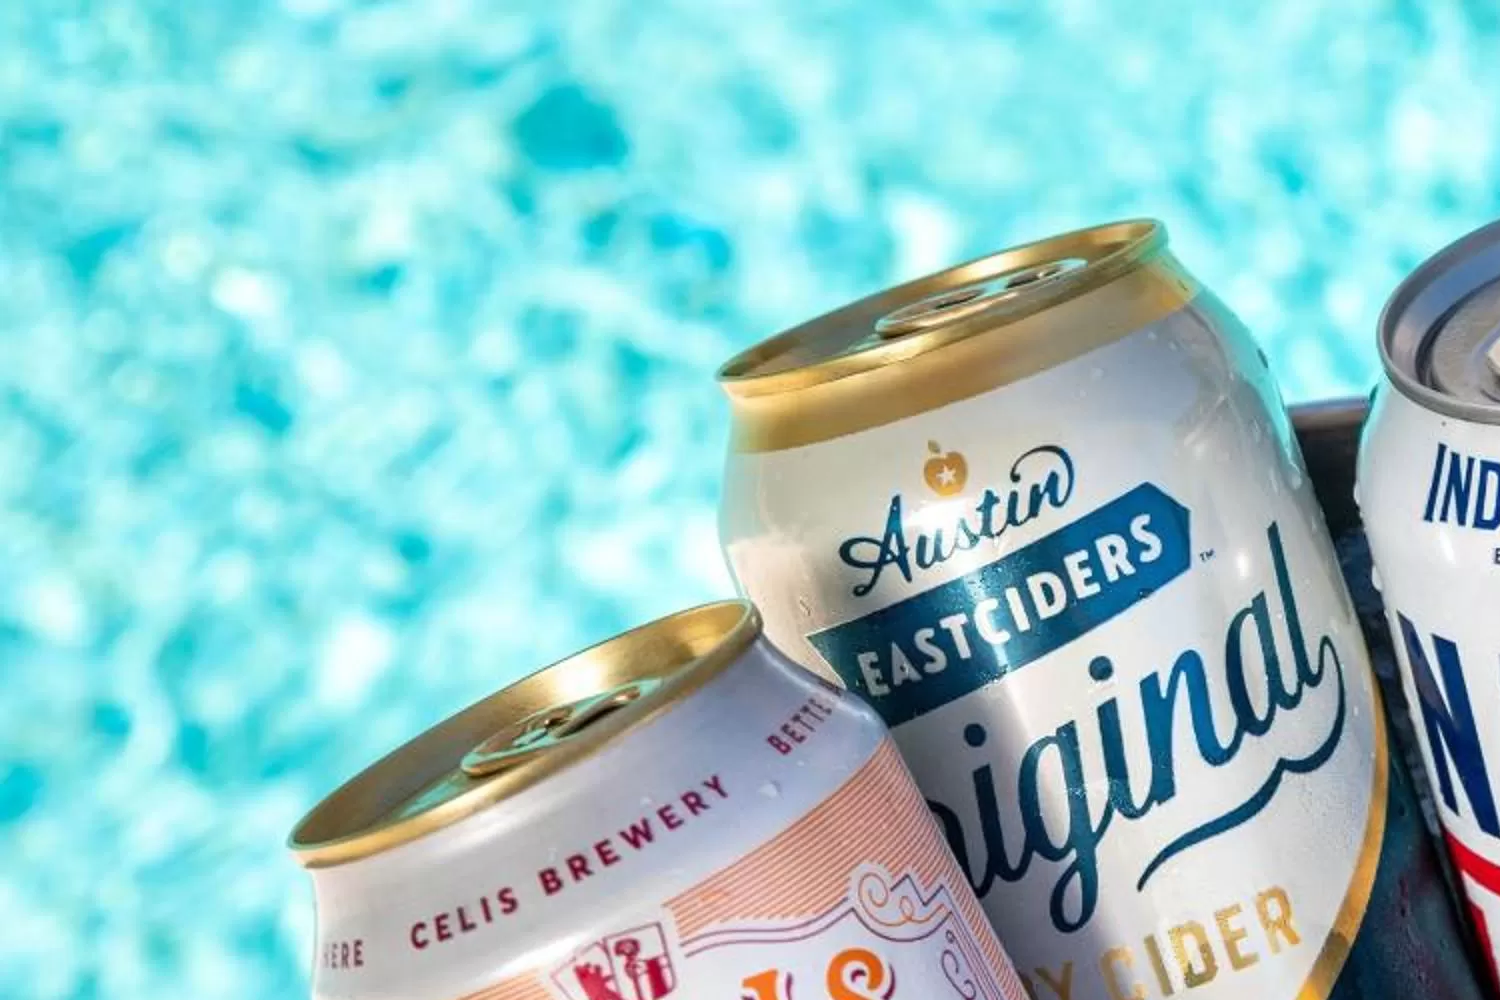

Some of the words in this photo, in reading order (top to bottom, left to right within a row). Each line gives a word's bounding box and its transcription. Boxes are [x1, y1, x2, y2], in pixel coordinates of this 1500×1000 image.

[839, 444, 1076, 597] Austin
[857, 513, 1163, 697] EASTCIDERS
[410, 887, 521, 950] CELIS
[538, 774, 730, 897] BREWERY
